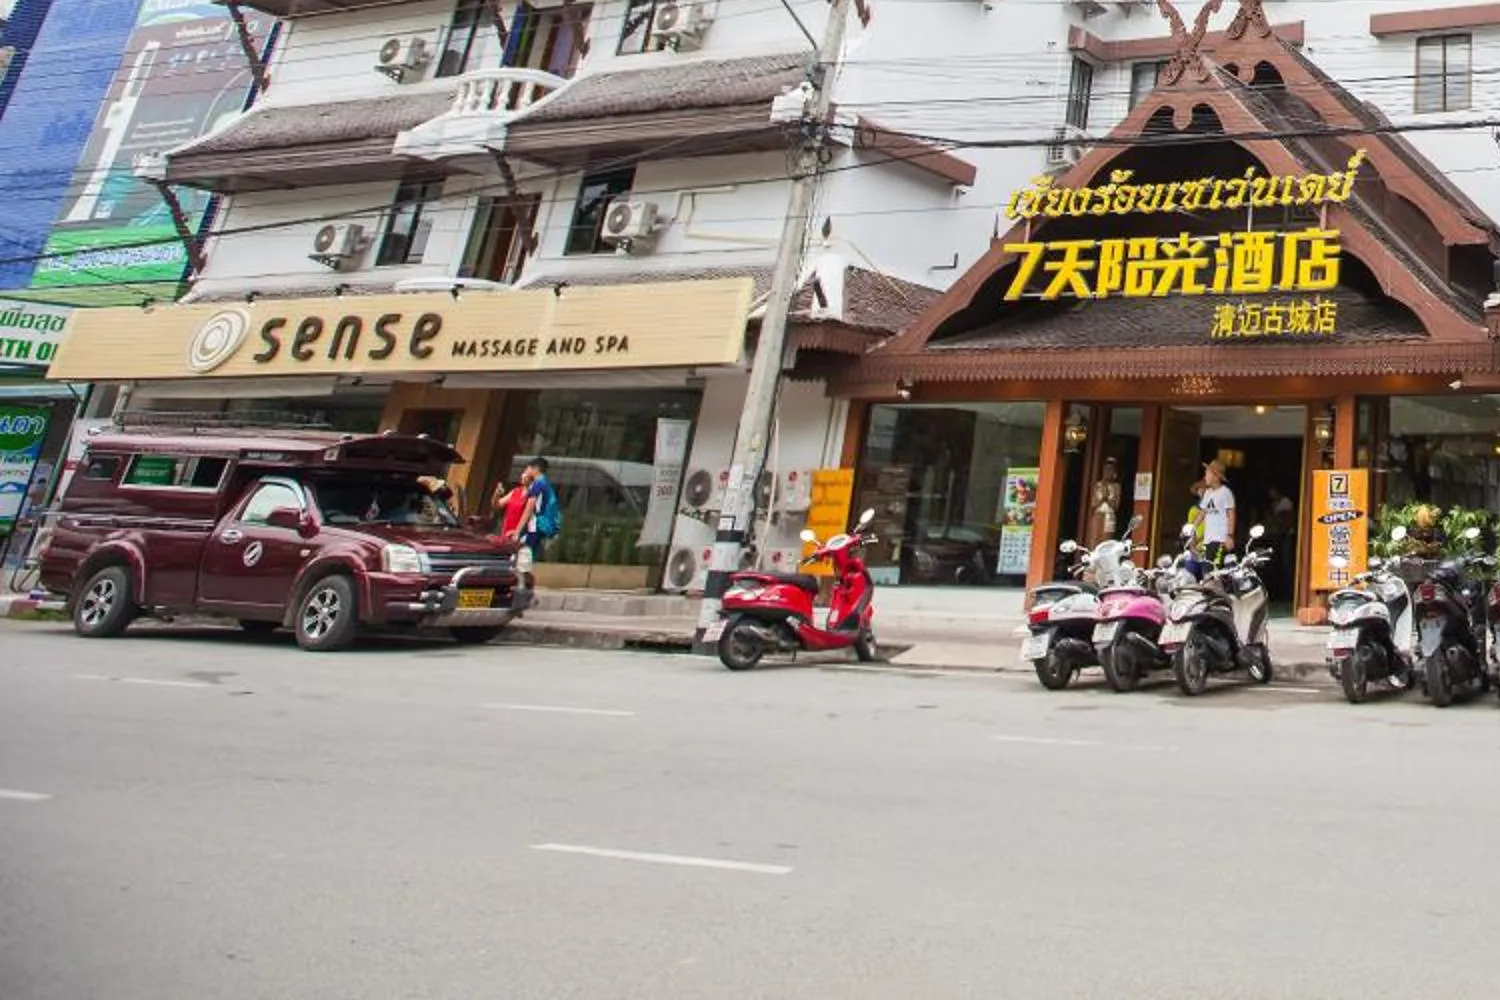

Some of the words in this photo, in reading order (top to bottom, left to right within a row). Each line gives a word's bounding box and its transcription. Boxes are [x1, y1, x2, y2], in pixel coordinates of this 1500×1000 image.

[1003, 229, 1341, 301] 7天阳光酒店
[254, 312, 443, 362] sense
[452, 338, 540, 357] MASSAGE
[546, 337, 587, 354] AND
[594, 335, 630, 353] SPA
[1333, 477, 1343, 490] 7
